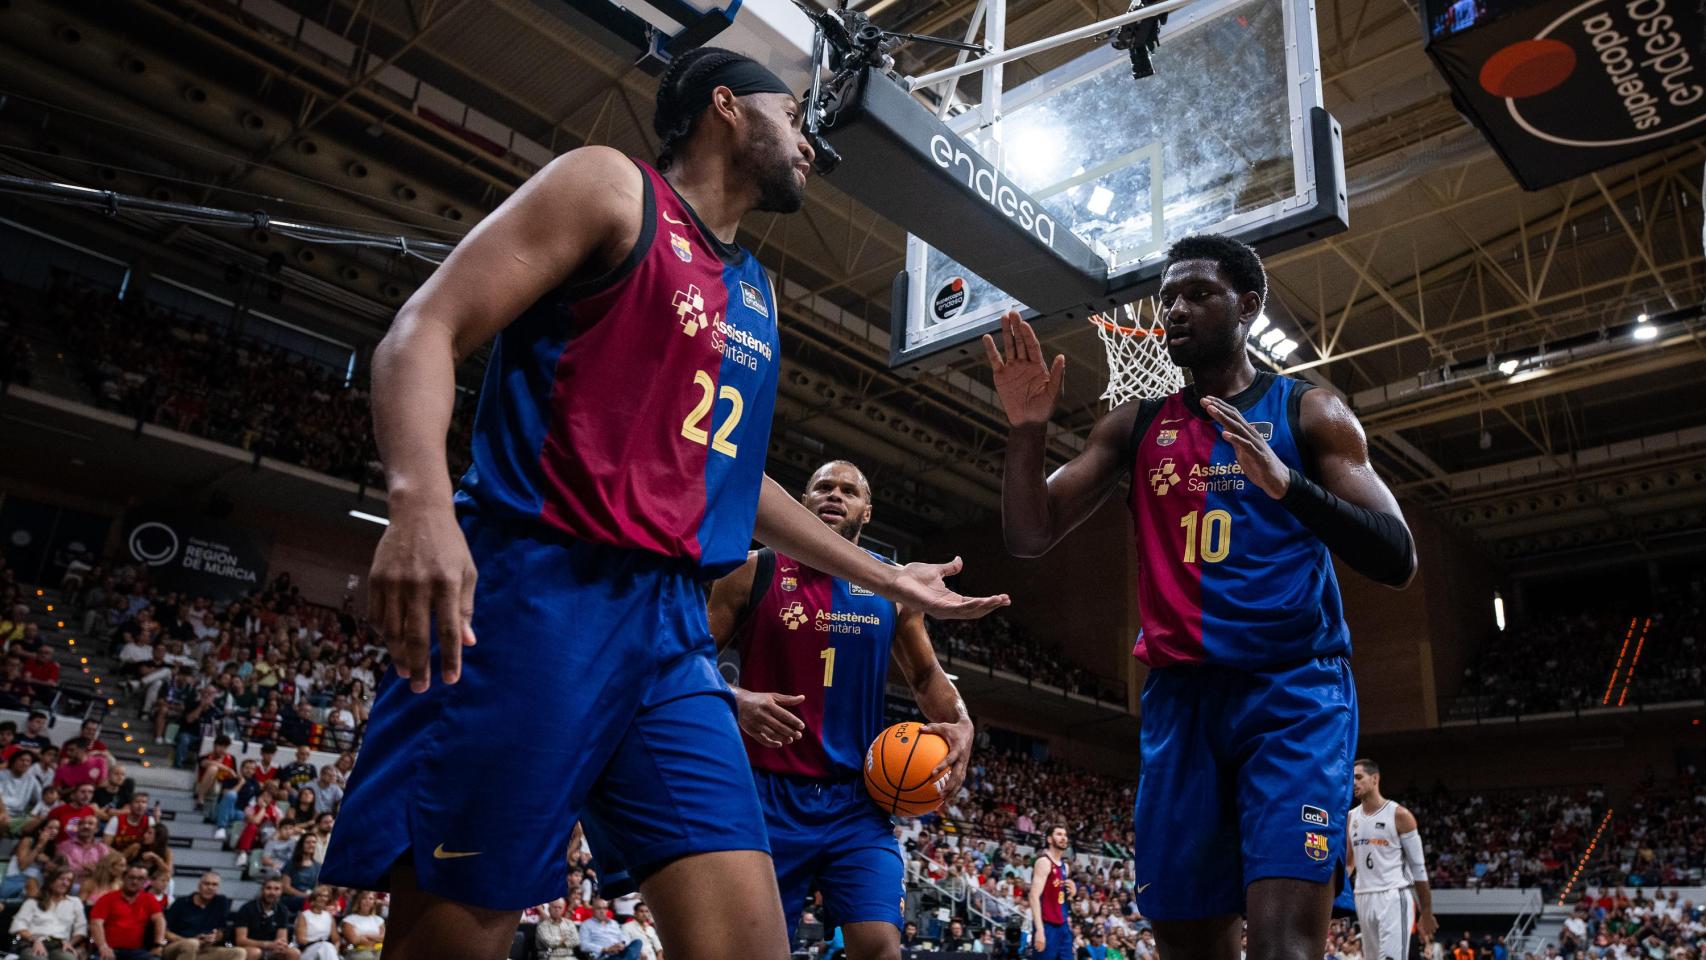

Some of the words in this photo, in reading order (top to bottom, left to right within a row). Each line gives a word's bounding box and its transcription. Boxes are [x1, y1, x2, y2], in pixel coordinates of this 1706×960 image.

[1582, 12, 1661, 130] supercopa
[1625, 0, 1704, 106] endesa
[930, 134, 1056, 248] endesa
[711, 330, 758, 371] Sanitària
[712, 311, 772, 362] Assistència
[681, 369, 744, 459] 22
[1187, 475, 1245, 492] Sanitària
[1189, 460, 1245, 477] Assistè
[1180, 509, 1232, 563] 10
[182, 556, 201, 570] DE
[204, 562, 257, 582] MURCIA
[814, 620, 861, 635] Sanitària
[815, 609, 880, 625] Assistència
[820, 647, 836, 687] 1
[1305, 812, 1323, 823] acb
[1366, 852, 1374, 869] 6
